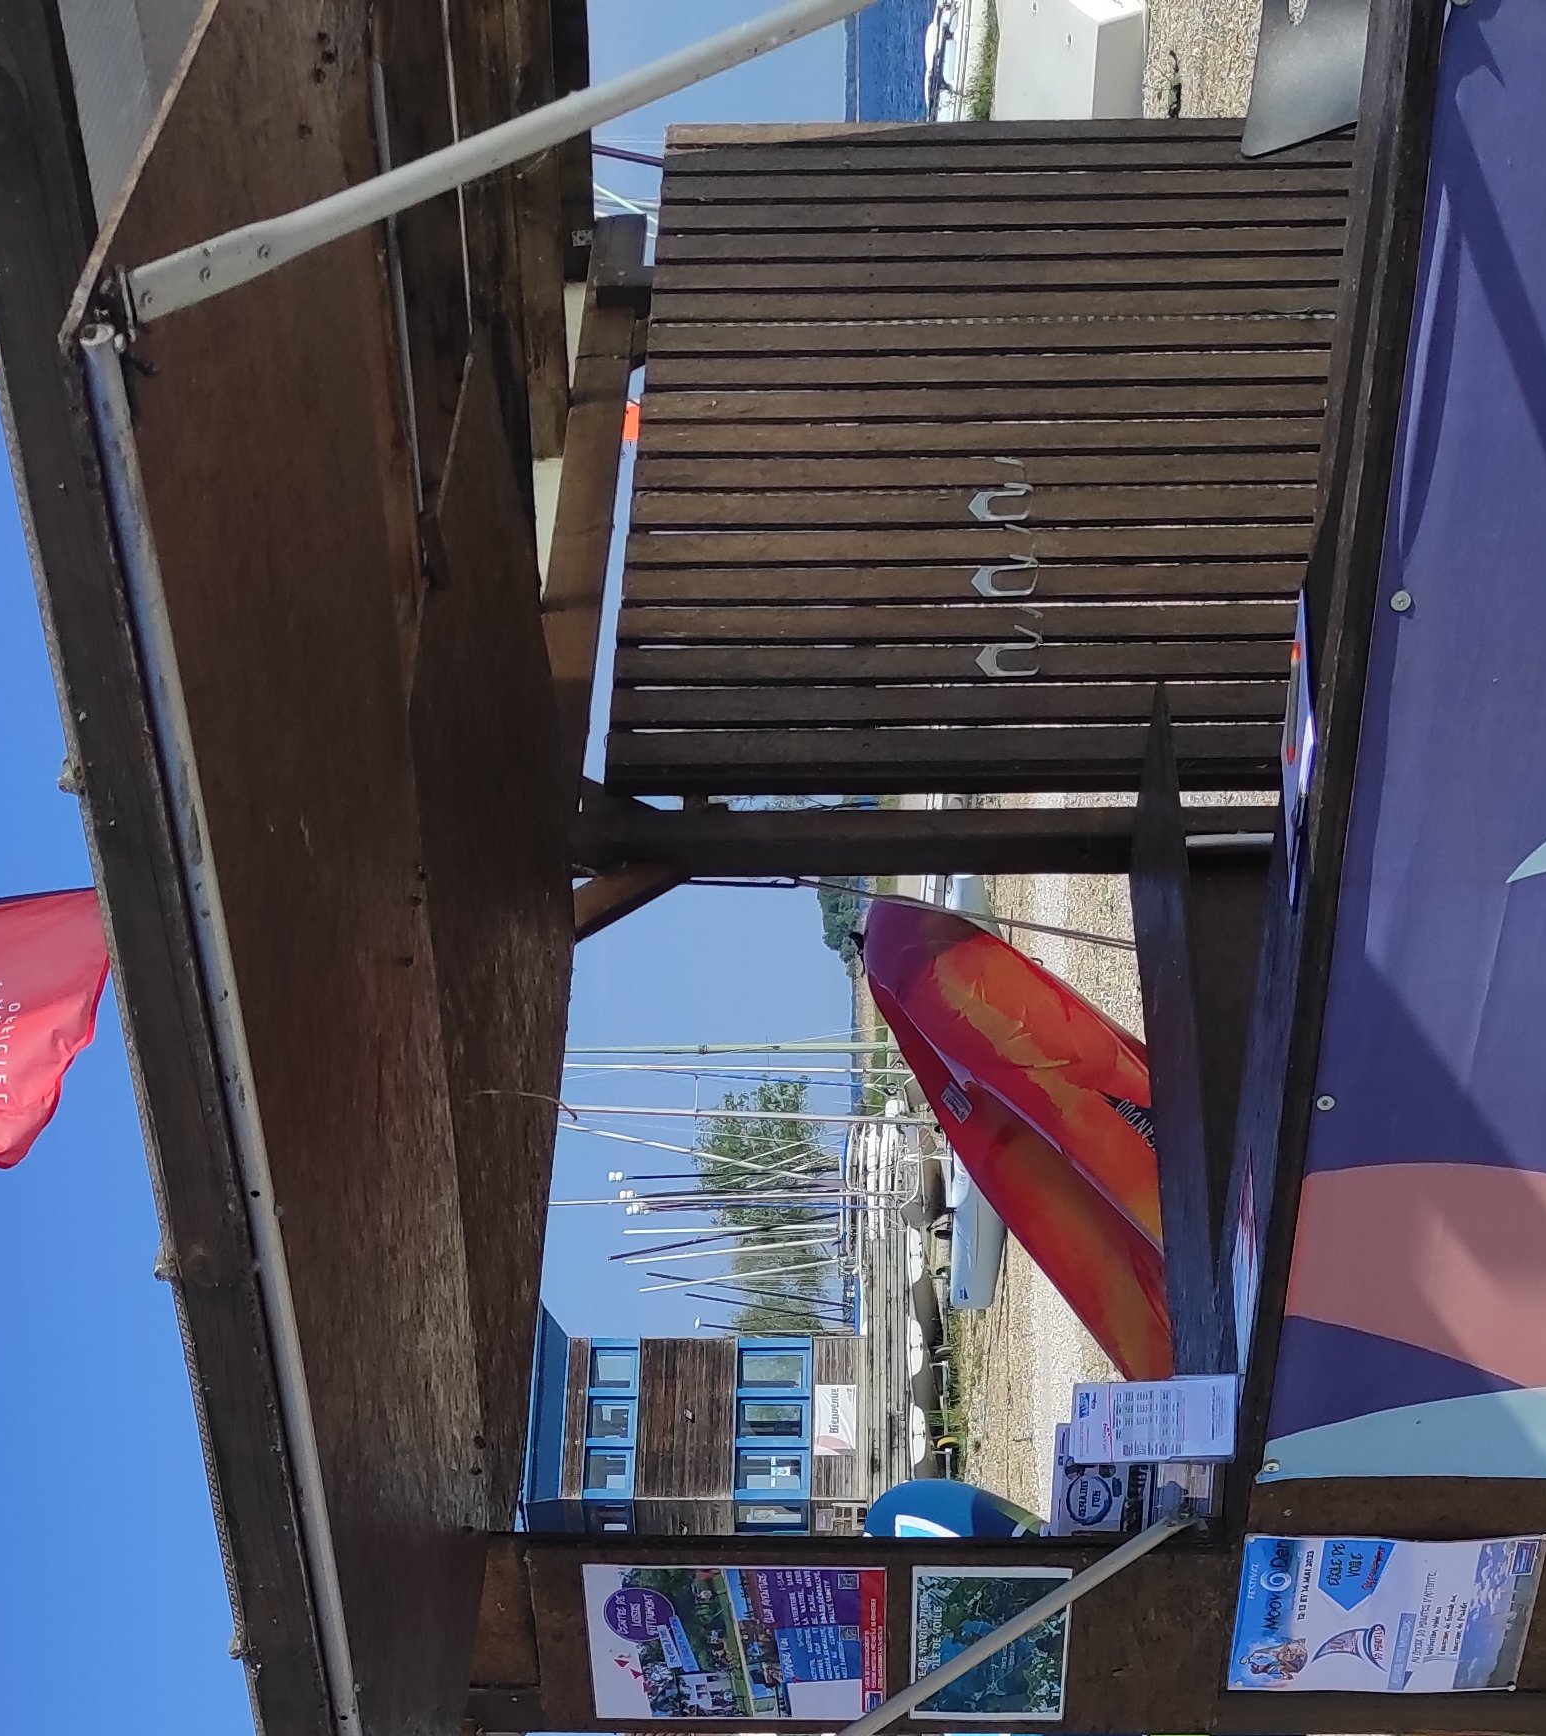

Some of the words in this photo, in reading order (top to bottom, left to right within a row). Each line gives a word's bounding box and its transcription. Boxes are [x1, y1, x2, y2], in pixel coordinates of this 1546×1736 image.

[1115, 1098, 1143, 1125] DUO
[828, 1387, 840, 1434] Bienvenue
[1246, 1562, 1260, 1600] FESTIVAL
[932, 1606, 943, 1634] VOILE
